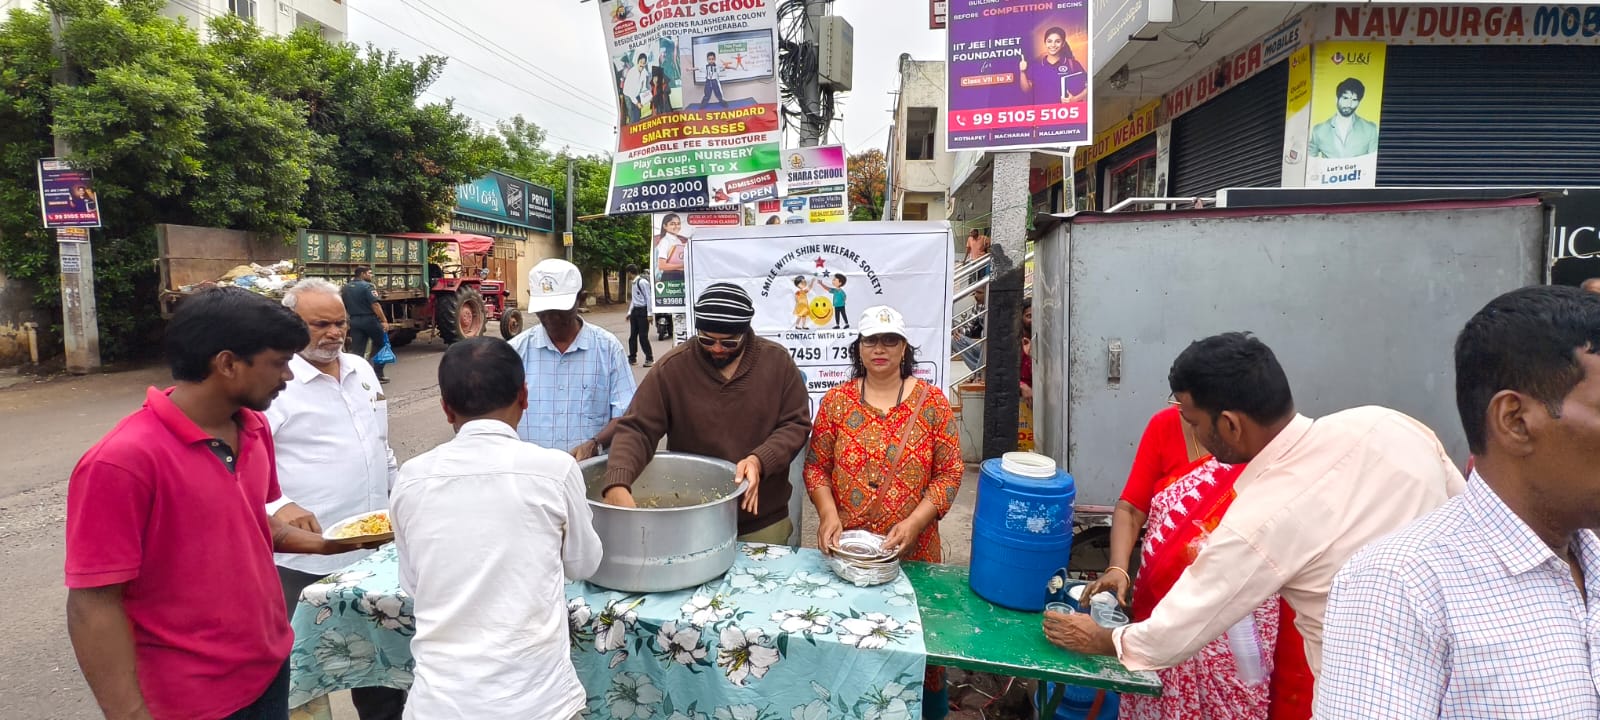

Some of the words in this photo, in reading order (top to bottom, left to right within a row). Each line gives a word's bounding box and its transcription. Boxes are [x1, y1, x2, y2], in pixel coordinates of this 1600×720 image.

[639, 6, 696, 28] GLOBAL
[699, 0, 766, 16] SCHOOL
[953, 12, 979, 20] BEFORE
[983, 2, 1054, 17] COMPETITION
[1057, 1, 1083, 9] BEGINS
[614, 37, 633, 47] BESIDE
[657, 21, 689, 33] GARDENS
[690, 15, 736, 27] RAJASHEKAR
[737, 11, 767, 20] COLONY
[1334, 6, 1409, 37] NAV
[1416, 6, 1525, 37] DURGA
[953, 43, 966, 52] IIT
[968, 40, 986, 50] JEE
[994, 37, 1022, 47] NEET
[952, 48, 1023, 62] FOUNDATION
[1165, 84, 1194, 118] NAV
[1264, 28, 1300, 57] MOBILES
[629, 110, 703, 134] INTERNATIONAL
[706, 107, 765, 121] STANDARD
[972, 112, 993, 125] 99
[997, 109, 1036, 124] 5105
[1040, 106, 1080, 121] 5105
[641, 127, 680, 144] SMART
[683, 121, 746, 137] CLASSES
[1087, 136, 1110, 162] FOOT
[1113, 115, 1144, 147] WEAR
[628, 142, 680, 159] AFFORDABLE
[683, 139, 702, 149] FEE
[708, 134, 768, 147] STRUCTURE
[633, 158, 651, 170] Play
[653, 154, 691, 167] Group,
[694, 147, 754, 161] NURSERY
[642, 165, 697, 180] CLASSES
[709, 163, 725, 173] To
[728, 162, 739, 171] X
[813, 168, 844, 180] SCHOOL
[1321, 169, 1362, 184] Loud!
[622, 186, 638, 199] 728
[641, 184, 667, 197] 800
[669, 180, 703, 194] 2000
[727, 174, 772, 190] ADMISSIONS
[531, 193, 549, 207] PRIYA
[740, 186, 773, 201] OPEN
[619, 199, 649, 213] 8019
[651, 198, 677, 211] 008
[679, 196, 705, 208] 009
[452, 219, 493, 233] RESTAURANT
[761, 269, 778, 297] SMILE
[775, 252, 795, 270] WITH
[795, 244, 821, 257] SHINE
[823, 244, 861, 263] WELFARE
[859, 260, 883, 296] SOCIETY
[785, 333, 815, 341] CONTACT
